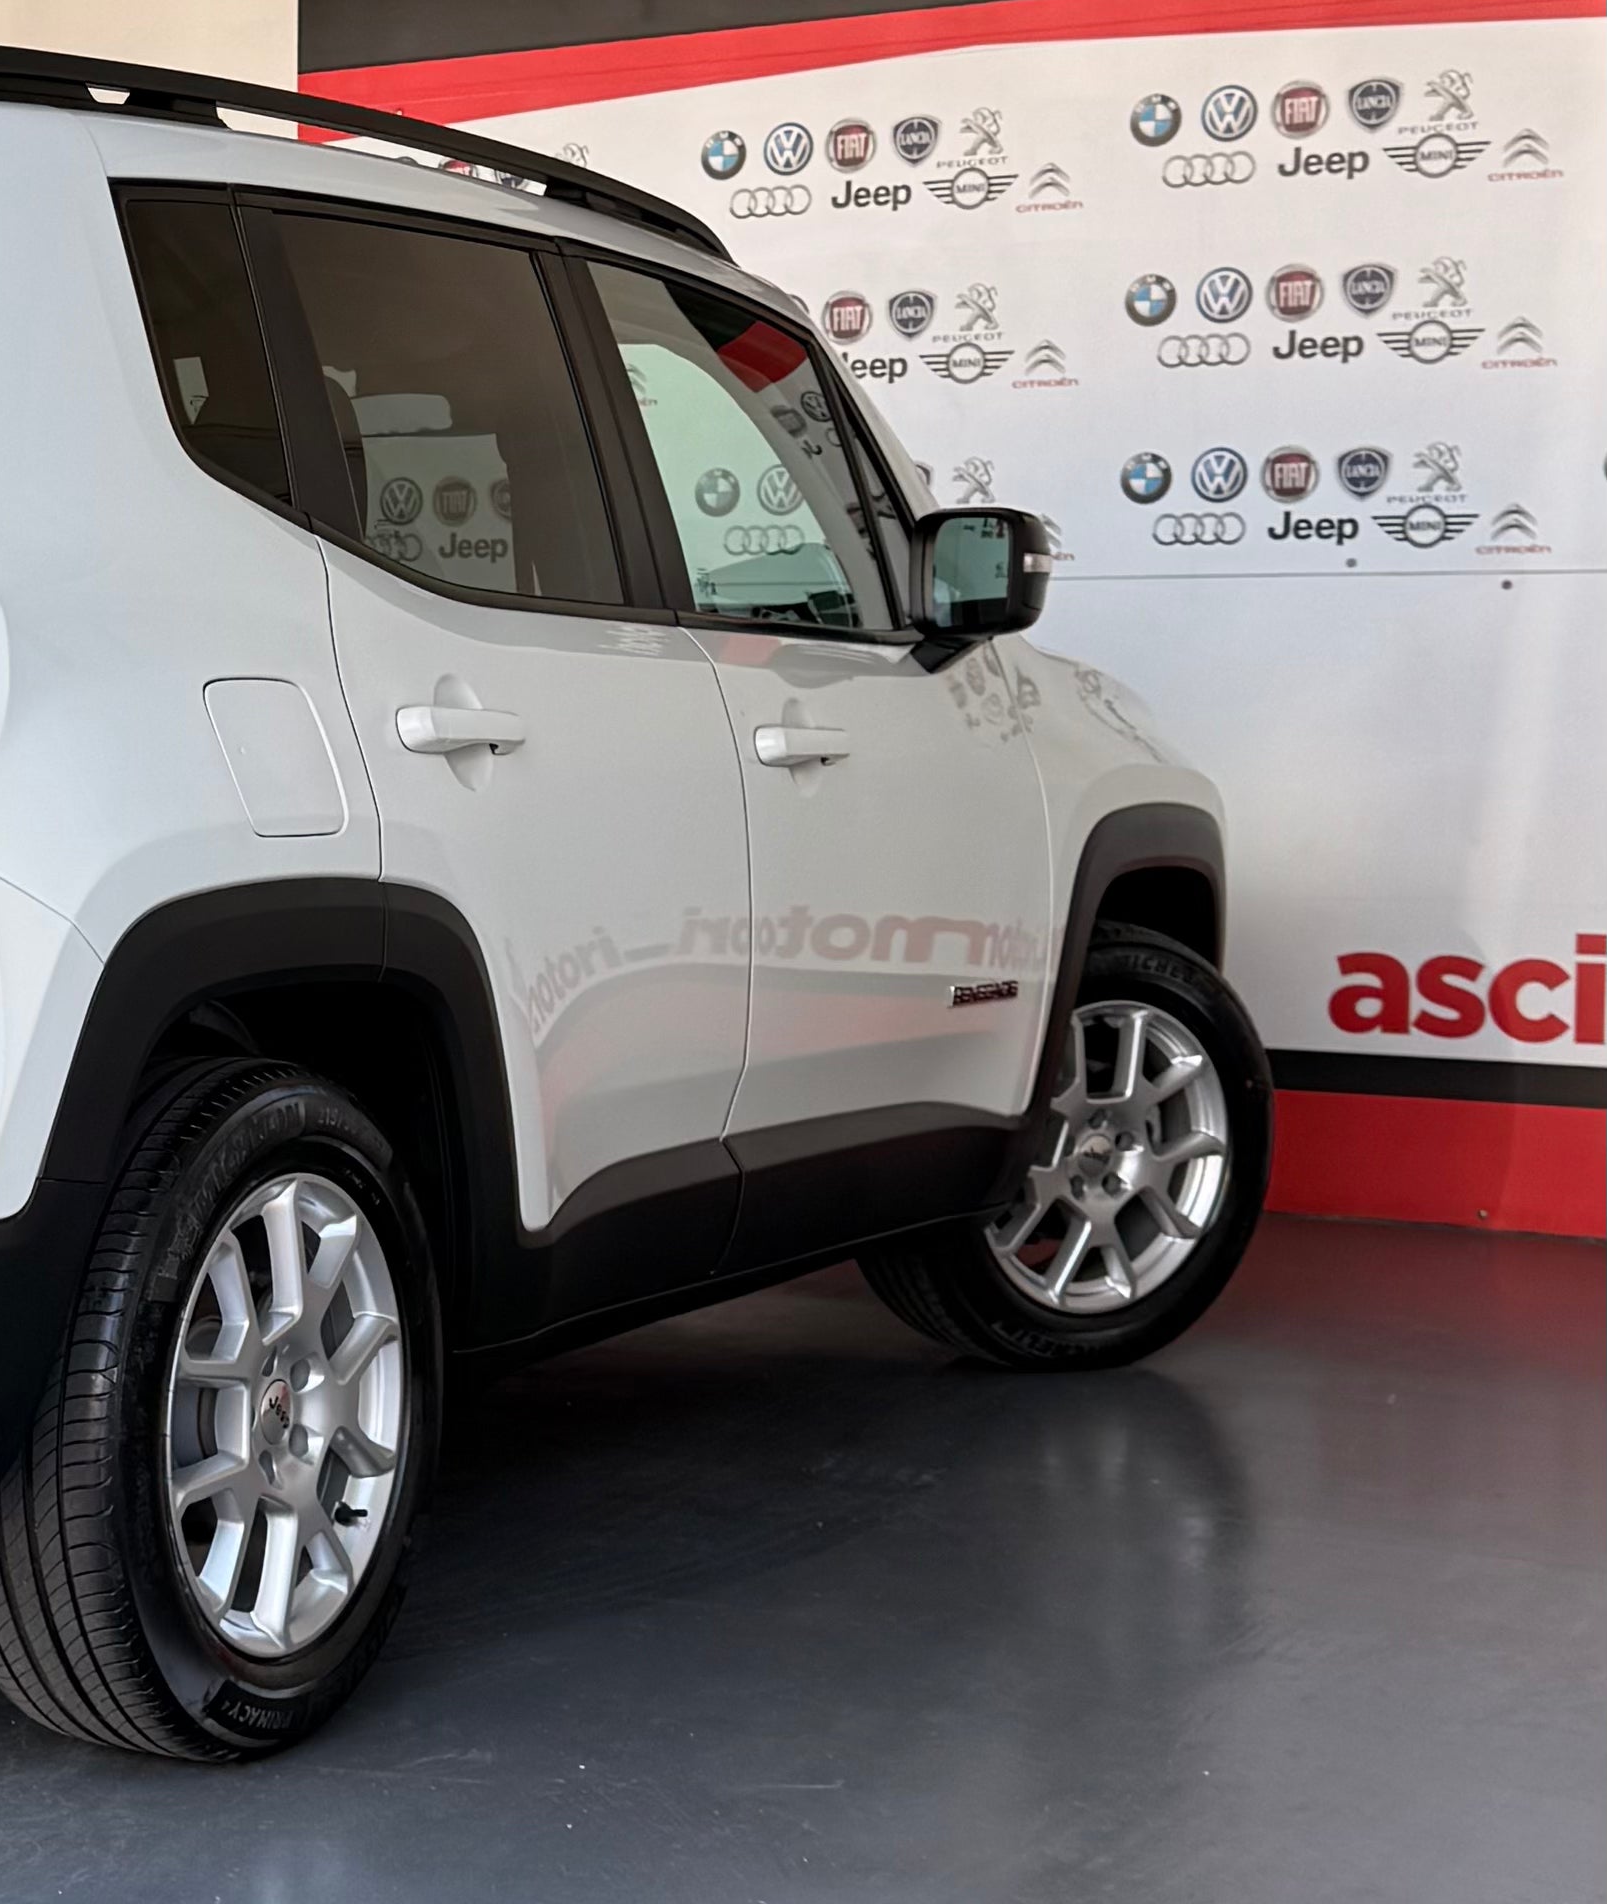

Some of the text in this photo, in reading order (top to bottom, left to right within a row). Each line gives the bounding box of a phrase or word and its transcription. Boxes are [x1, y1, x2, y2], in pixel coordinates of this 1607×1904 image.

[1284, 95, 1319, 125] FIAT
[1397, 121, 1479, 135] PEUGEOT
[836, 132, 867, 161] FIAT
[936, 156, 1009, 169] PEUGEOT
[1278, 147, 1370, 180] Jeep
[1419, 149, 1453, 162] MINI
[831, 180, 912, 211] Jeep
[955, 183, 986, 194] MINI
[1279, 280, 1313, 308] FIAT
[1392, 307, 1473, 321] PEUGEOT
[832, 305, 864, 332] FIAT
[932, 331, 1006, 343] PEUGEOT
[952, 357, 981, 368] MINI
[1272, 330, 1365, 364] Jeep
[1414, 336, 1448, 348] MINI
[1274, 462, 1309, 489] FIAT
[1387, 493, 1469, 504] PEUGEOT
[1267, 511, 1359, 546] Jeep
[1408, 520, 1442, 532] MINI
[438, 532, 509, 563] Jeep
[1328, 933, 1607, 1045] asci
[228, 1700, 294, 1729] PRIMACY
